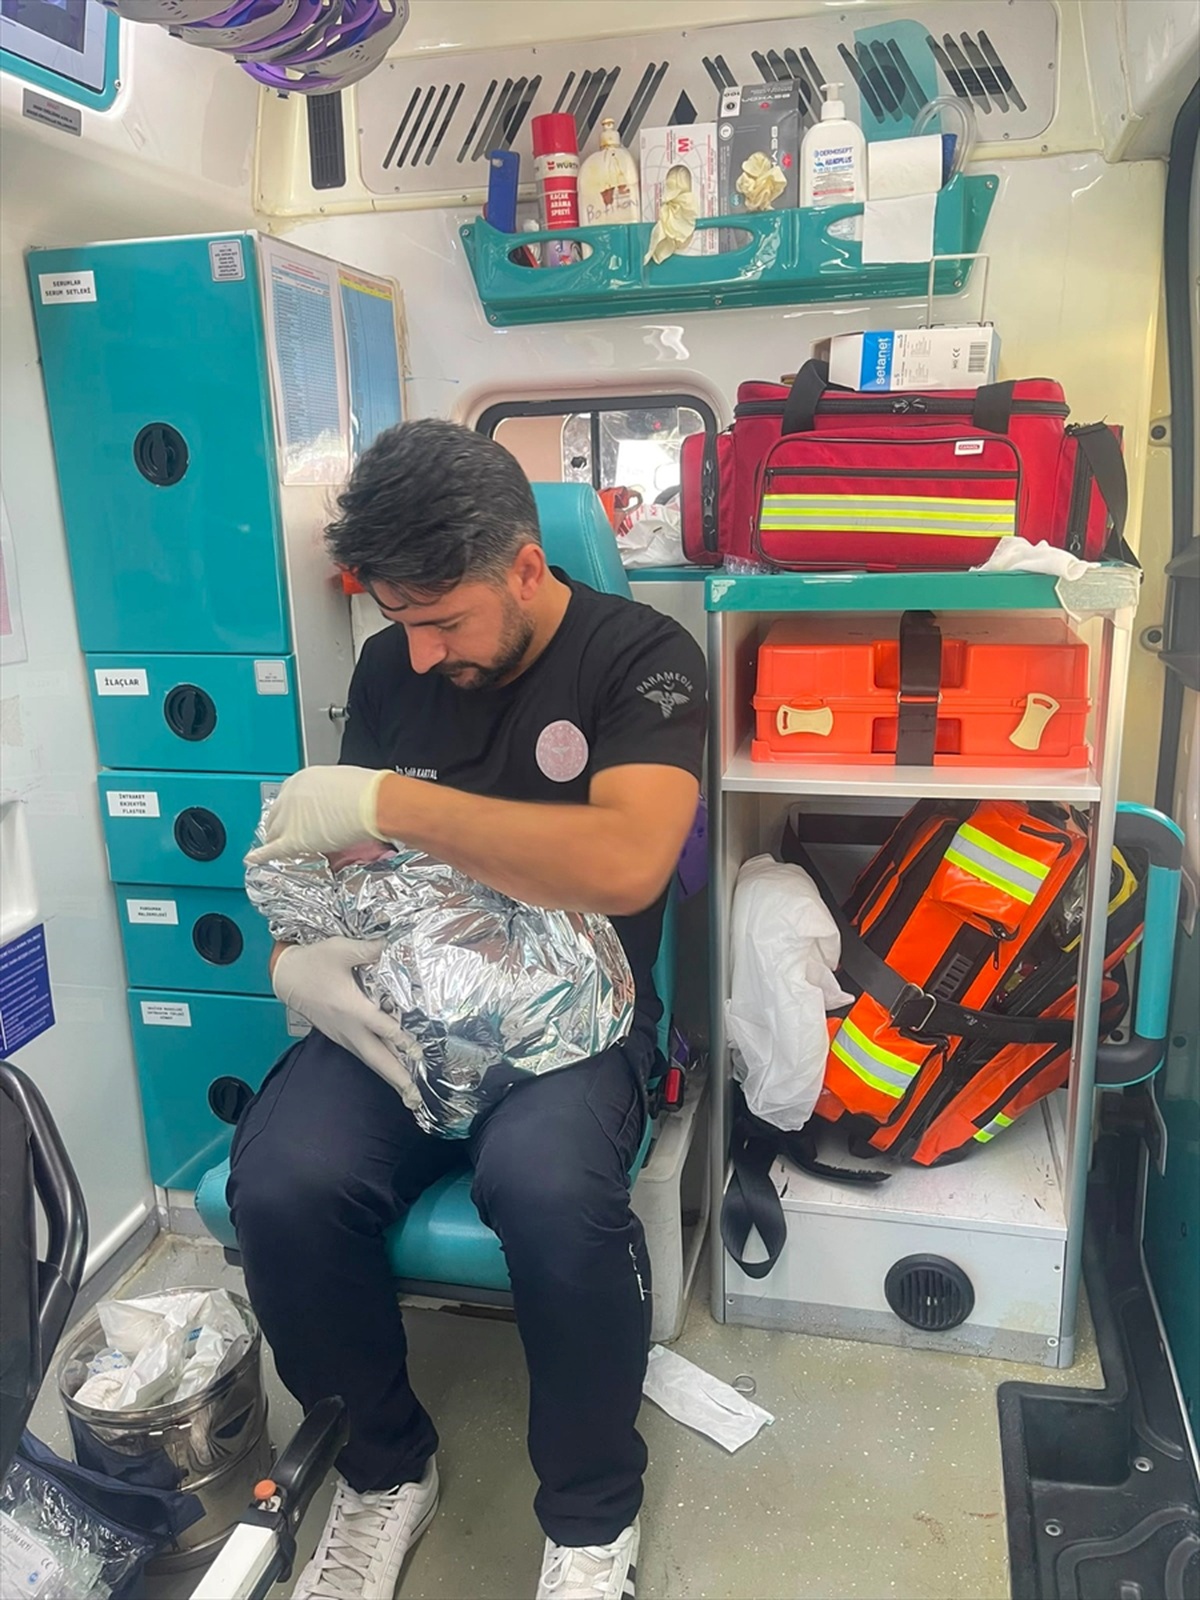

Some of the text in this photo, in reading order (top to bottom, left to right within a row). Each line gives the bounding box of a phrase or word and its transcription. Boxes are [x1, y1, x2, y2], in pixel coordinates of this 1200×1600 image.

[551, 200, 572, 209] ARAMA
[52, 279, 81, 288] SERUMLAR
[45, 286, 91, 297] SERUM SETLERİ
[876, 337, 888, 385] setanet
[104, 676, 139, 688] İLAÇLAR
